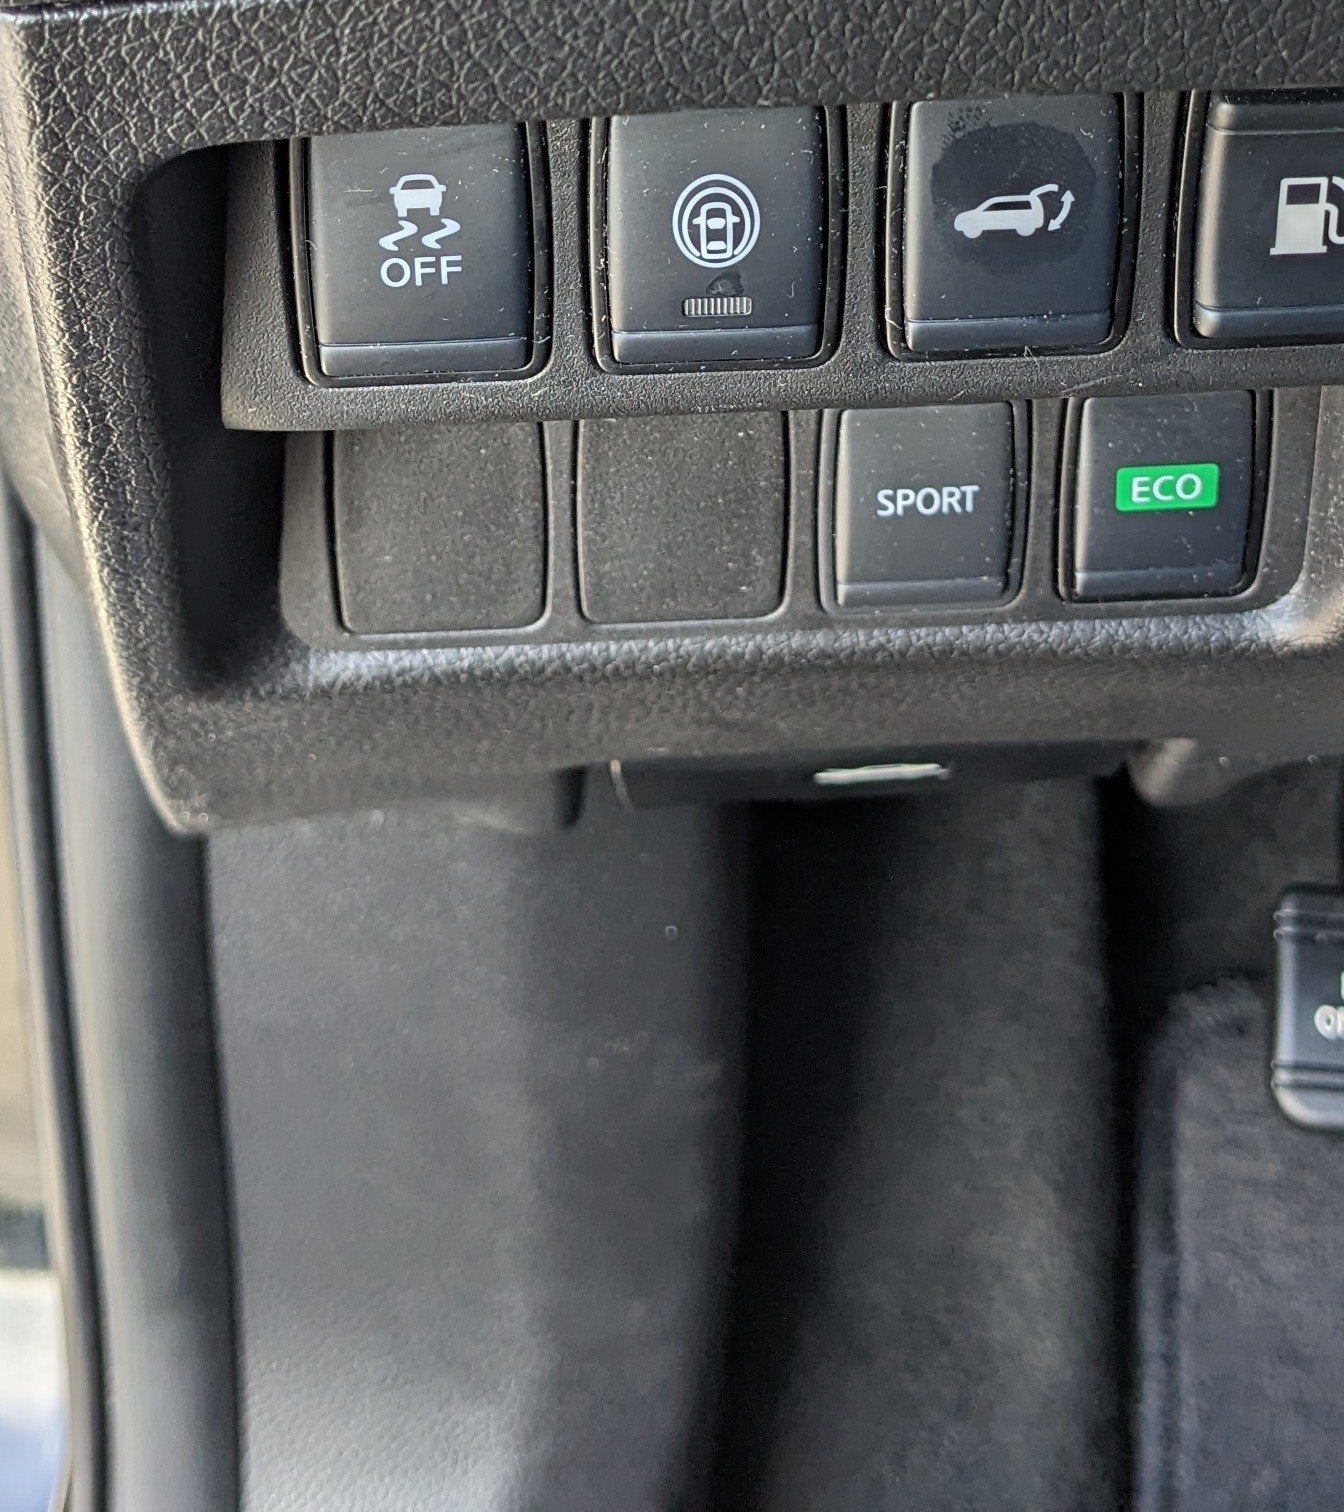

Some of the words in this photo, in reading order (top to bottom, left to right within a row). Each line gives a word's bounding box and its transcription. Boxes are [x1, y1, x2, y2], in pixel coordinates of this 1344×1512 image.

[378, 255, 463, 290] OFF
[874, 483, 980, 519] SPORT
[1130, 474, 1203, 505] ECO
